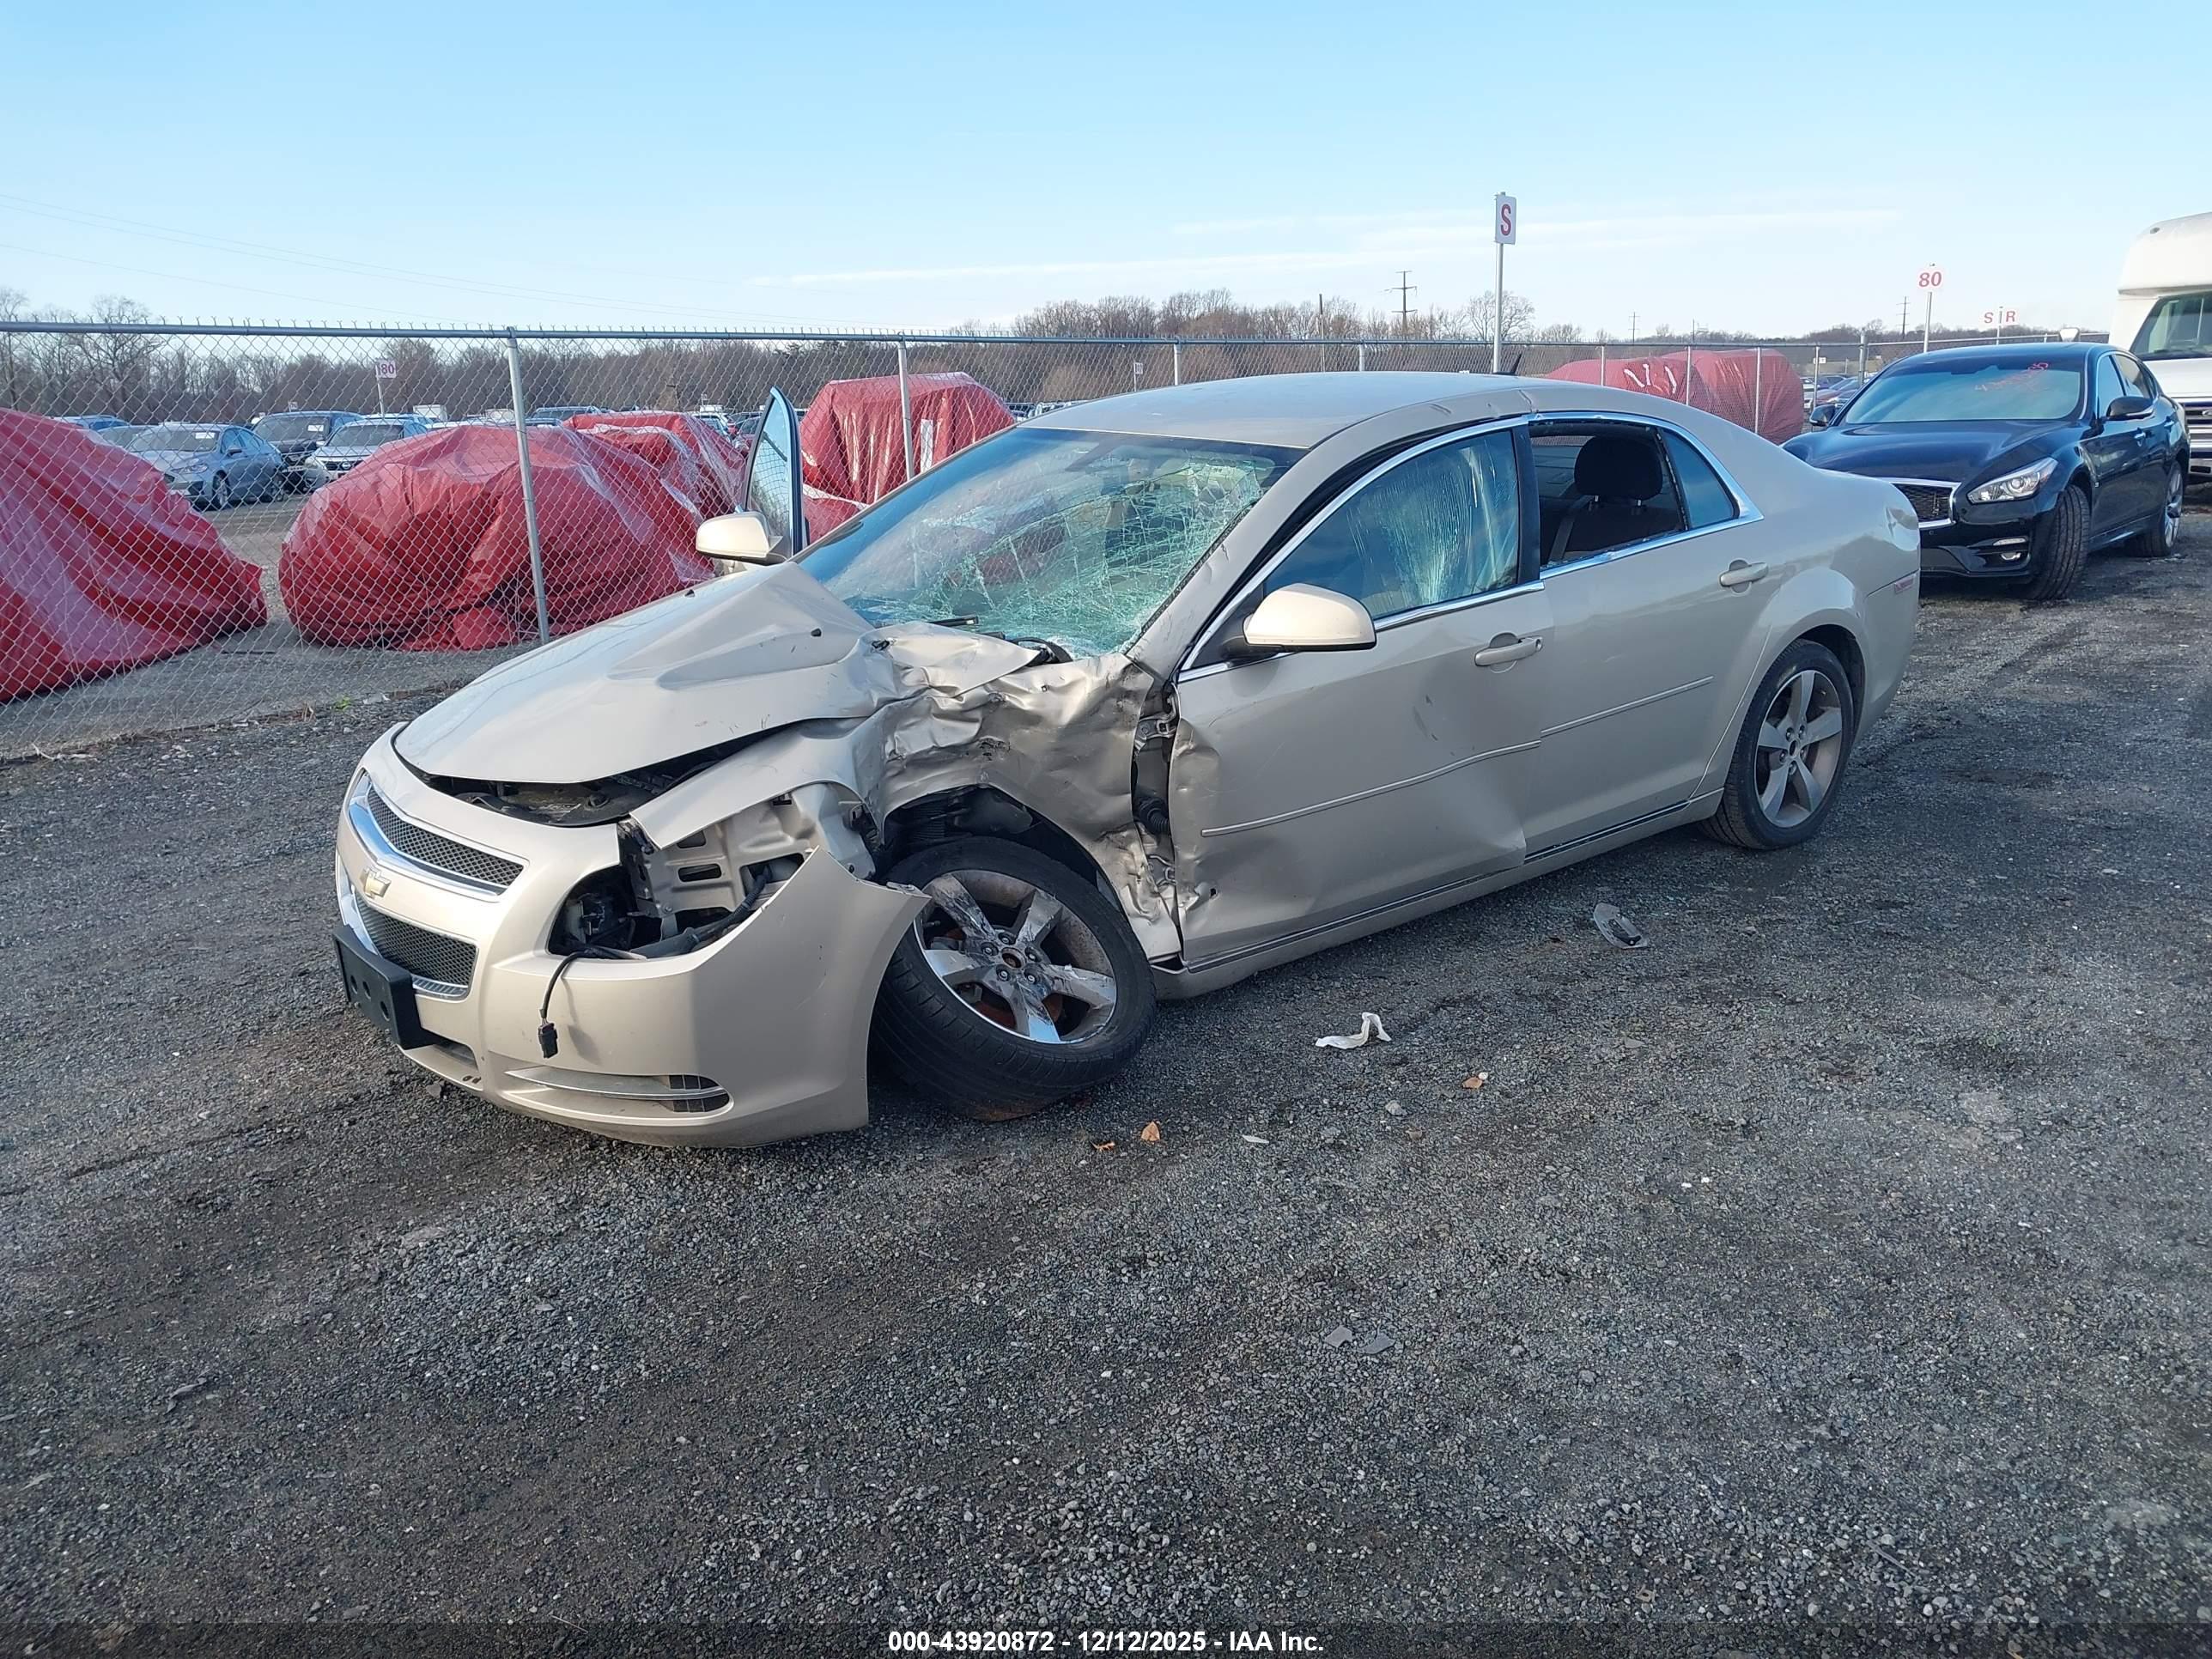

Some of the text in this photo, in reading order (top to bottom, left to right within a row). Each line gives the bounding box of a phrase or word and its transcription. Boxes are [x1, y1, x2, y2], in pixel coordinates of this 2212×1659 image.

[1501, 204, 1511, 236] S
[1918, 271, 1942, 288] 80
[1984, 312, 1994, 324] S
[2006, 310, 2016, 323] R
